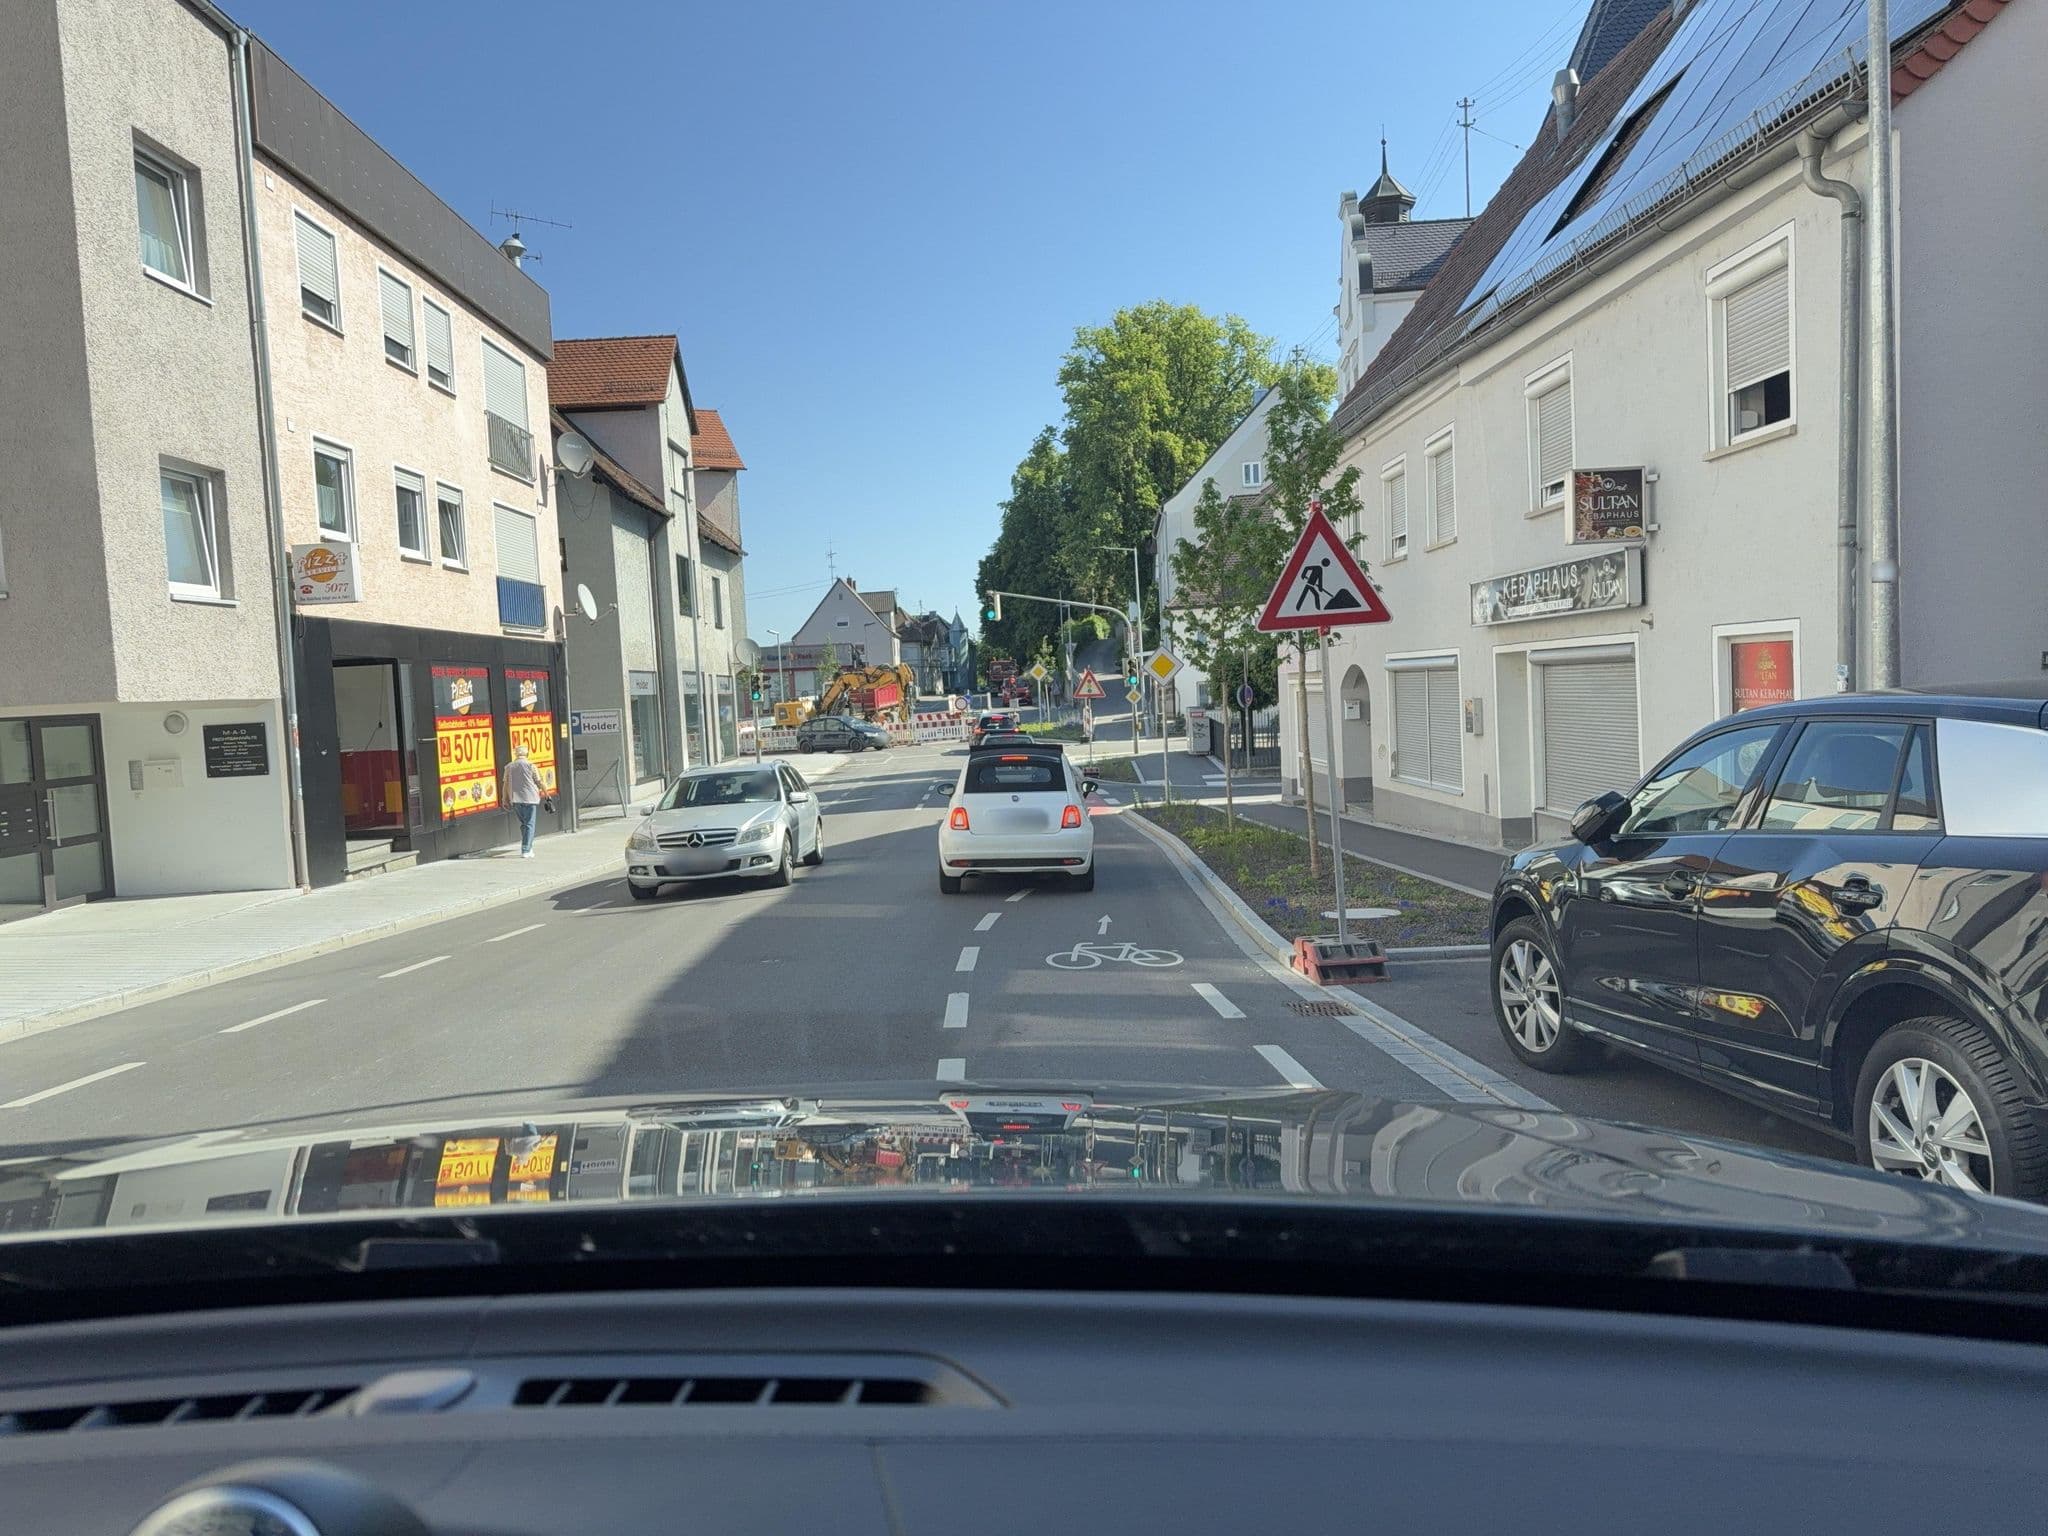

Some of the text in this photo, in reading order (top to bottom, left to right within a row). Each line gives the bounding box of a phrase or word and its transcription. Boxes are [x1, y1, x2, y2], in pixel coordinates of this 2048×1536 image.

[1579, 494, 1639, 511] SULTAN
[1580, 510, 1640, 520] KEBAPHAUS
[324, 582, 349, 593] 5077
[1503, 564, 1578, 599] KEBAPHAUS
[1592, 578, 1623, 600] SULTAN
[1734, 688, 1759, 698] SULTAN
[582, 722, 617, 731] Holder
[454, 732, 489, 764] 5077
[522, 727, 551, 754] 5078
